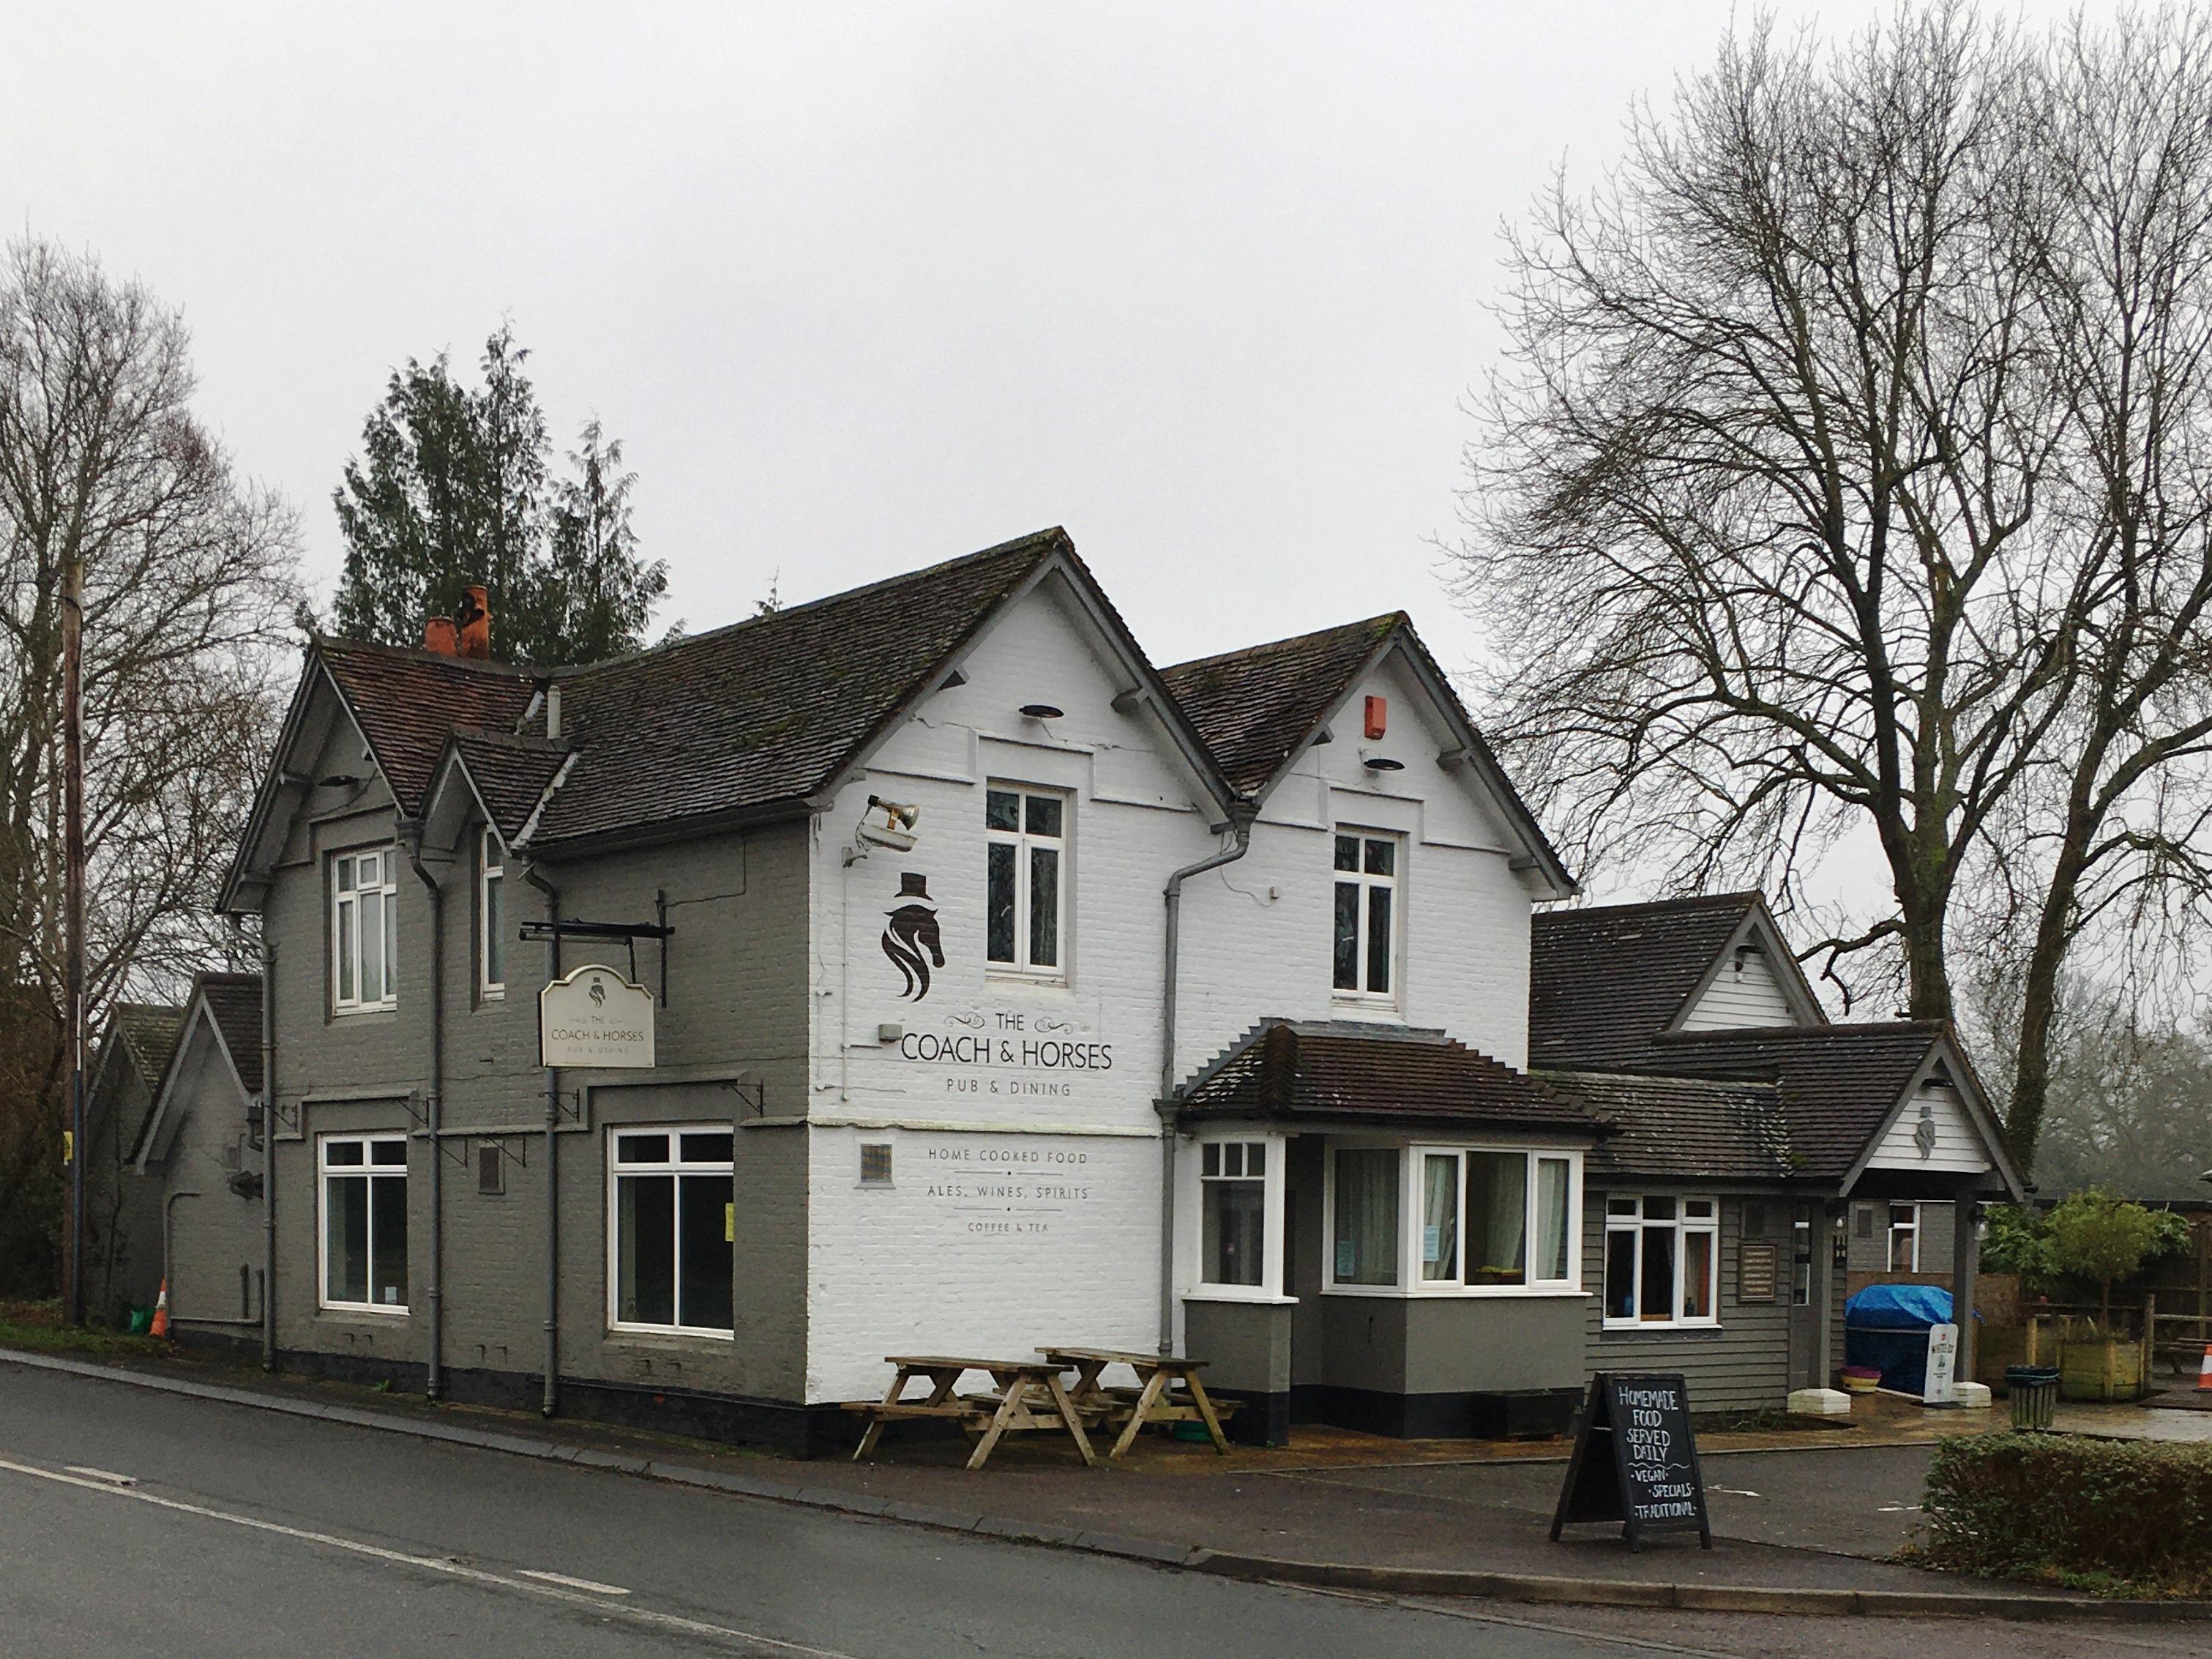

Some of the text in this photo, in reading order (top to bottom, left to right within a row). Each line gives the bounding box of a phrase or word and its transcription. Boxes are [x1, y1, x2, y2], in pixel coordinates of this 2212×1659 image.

[591, 1015, 605, 1024] THE
[995, 1013, 1025, 1032] THE
[551, 1029, 644, 1042] COACH & HORSES
[901, 1032, 1112, 1070] COACH & HORSES
[947, 1078, 1070, 1097] PUB & DINING
[928, 1148, 1087, 1164] HOME COOKED FOOD
[927, 1185, 1088, 1199] ALES, WINES, SPIRITS
[968, 1222, 1048, 1232] COFFEE & TEA
[1618, 1386, 1679, 1410] HOMEMADE
[1632, 1409, 1662, 1427] FOOD
[1626, 1429, 1670, 1447] SERVED
[1634, 1444, 1667, 1462] DAILY
